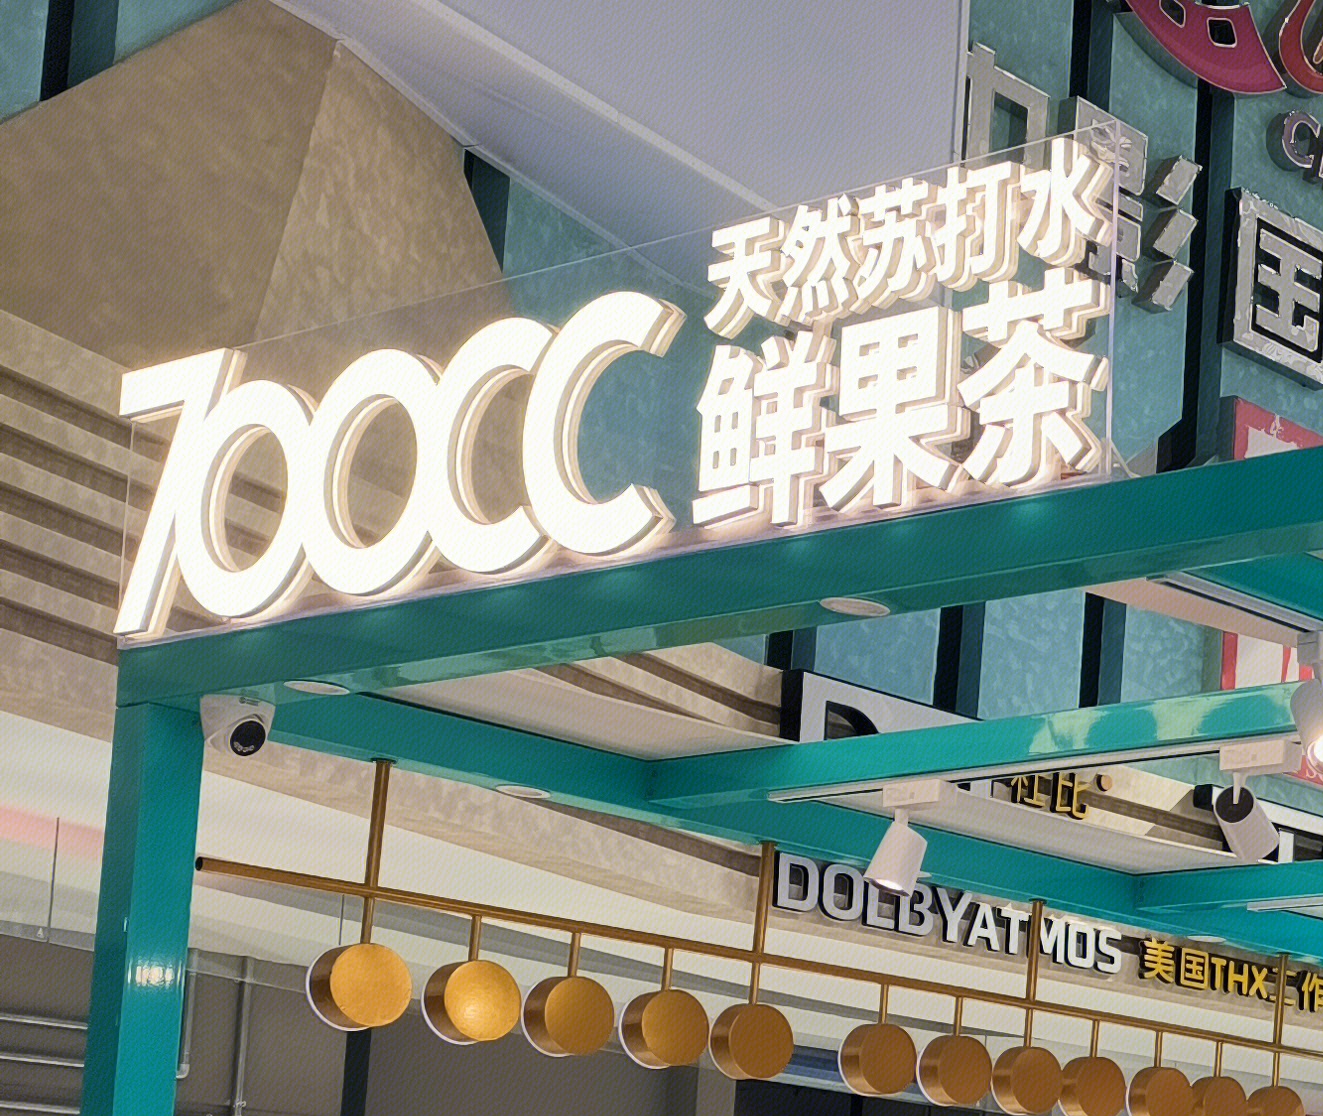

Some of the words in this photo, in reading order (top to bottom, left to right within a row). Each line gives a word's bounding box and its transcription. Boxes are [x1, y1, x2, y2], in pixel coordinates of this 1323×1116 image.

[705, 136, 1113, 337] 天然苏打水
[113, 290, 688, 640] 700CC
[692, 267, 1107, 527] 鲜果茶
